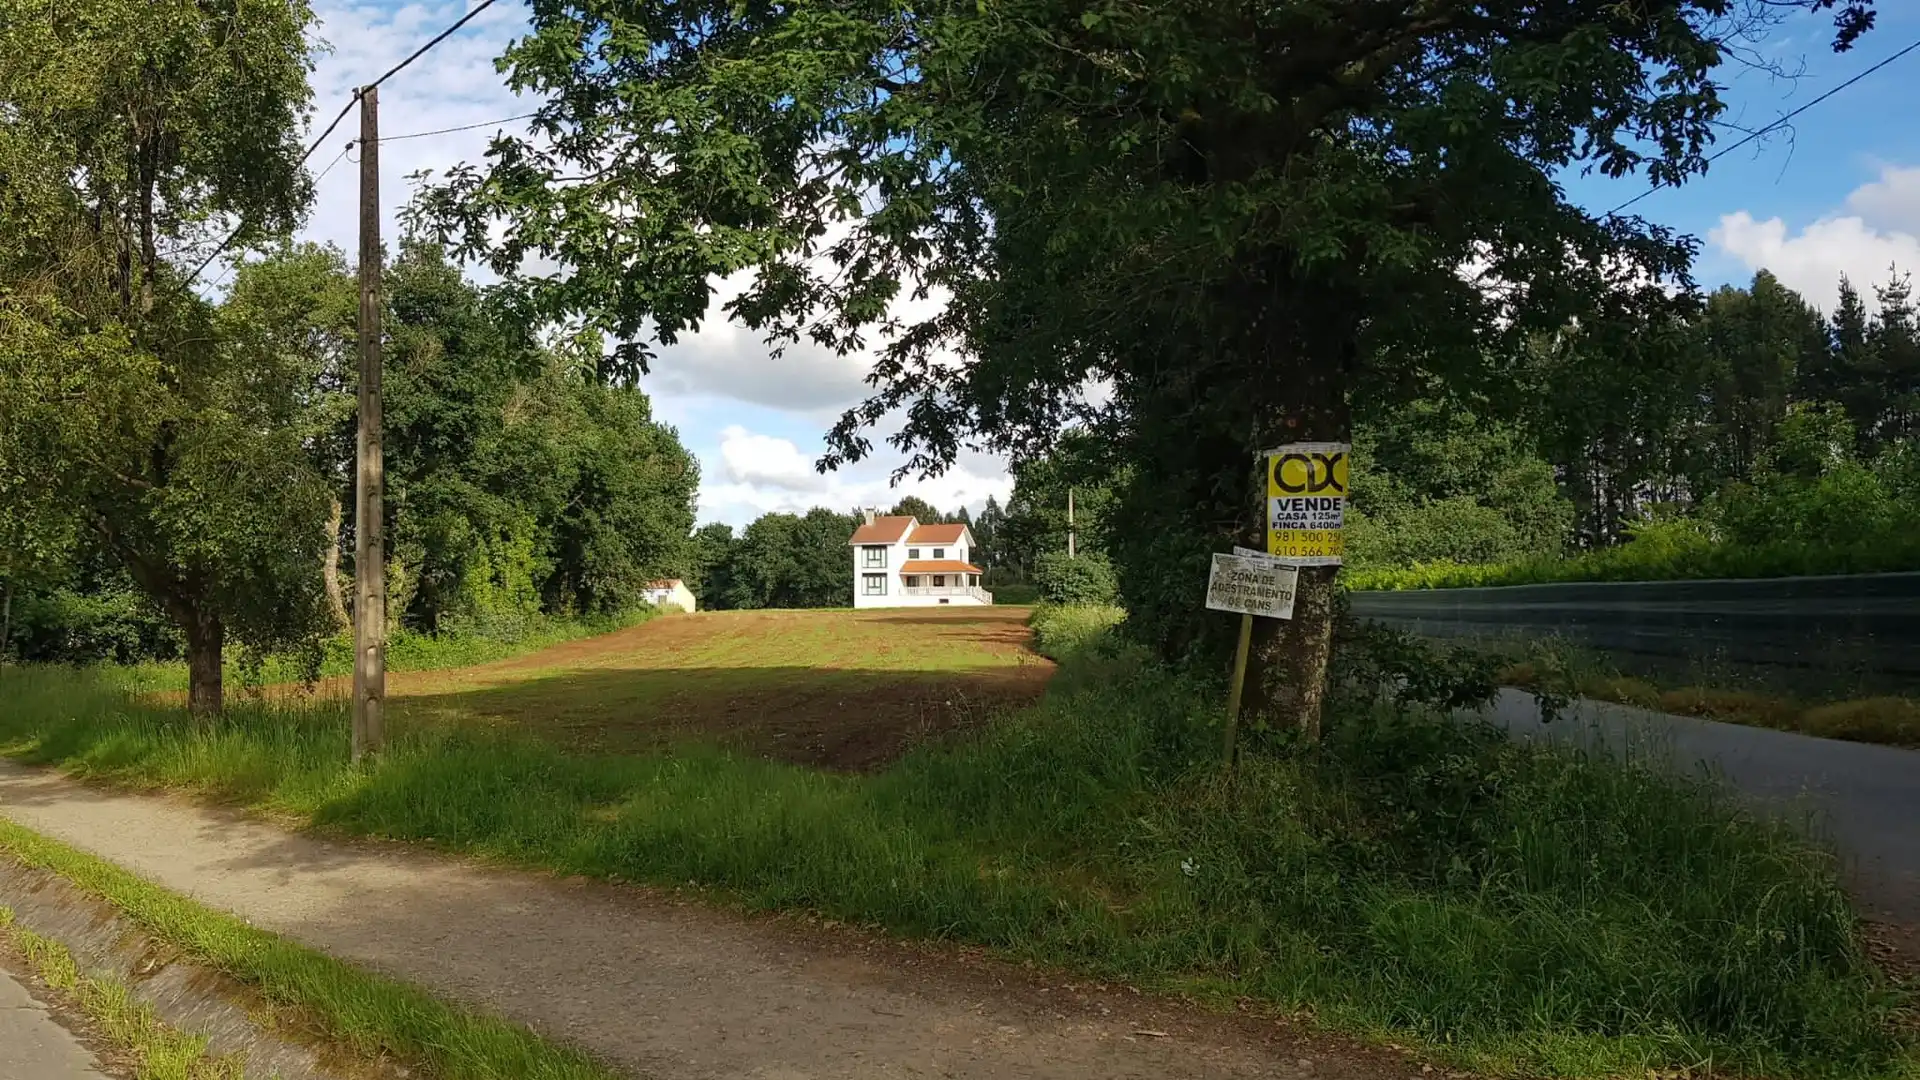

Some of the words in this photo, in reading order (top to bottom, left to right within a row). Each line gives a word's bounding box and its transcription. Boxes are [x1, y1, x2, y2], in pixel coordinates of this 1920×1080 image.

[1277, 498, 1341, 511] VENDE
[1277, 512, 1308, 520] CASA
[1272, 521, 1307, 529] FINCA
[1275, 531, 1295, 542] 981
[1301, 532, 1324, 542] 500
[1275, 545, 1297, 556] 610
[1301, 546, 1323, 556] 566
[1231, 571, 1258, 584] ZONA
[1262, 575, 1275, 585] DE
[1210, 580, 1292, 601] ADESTRAMENTO
